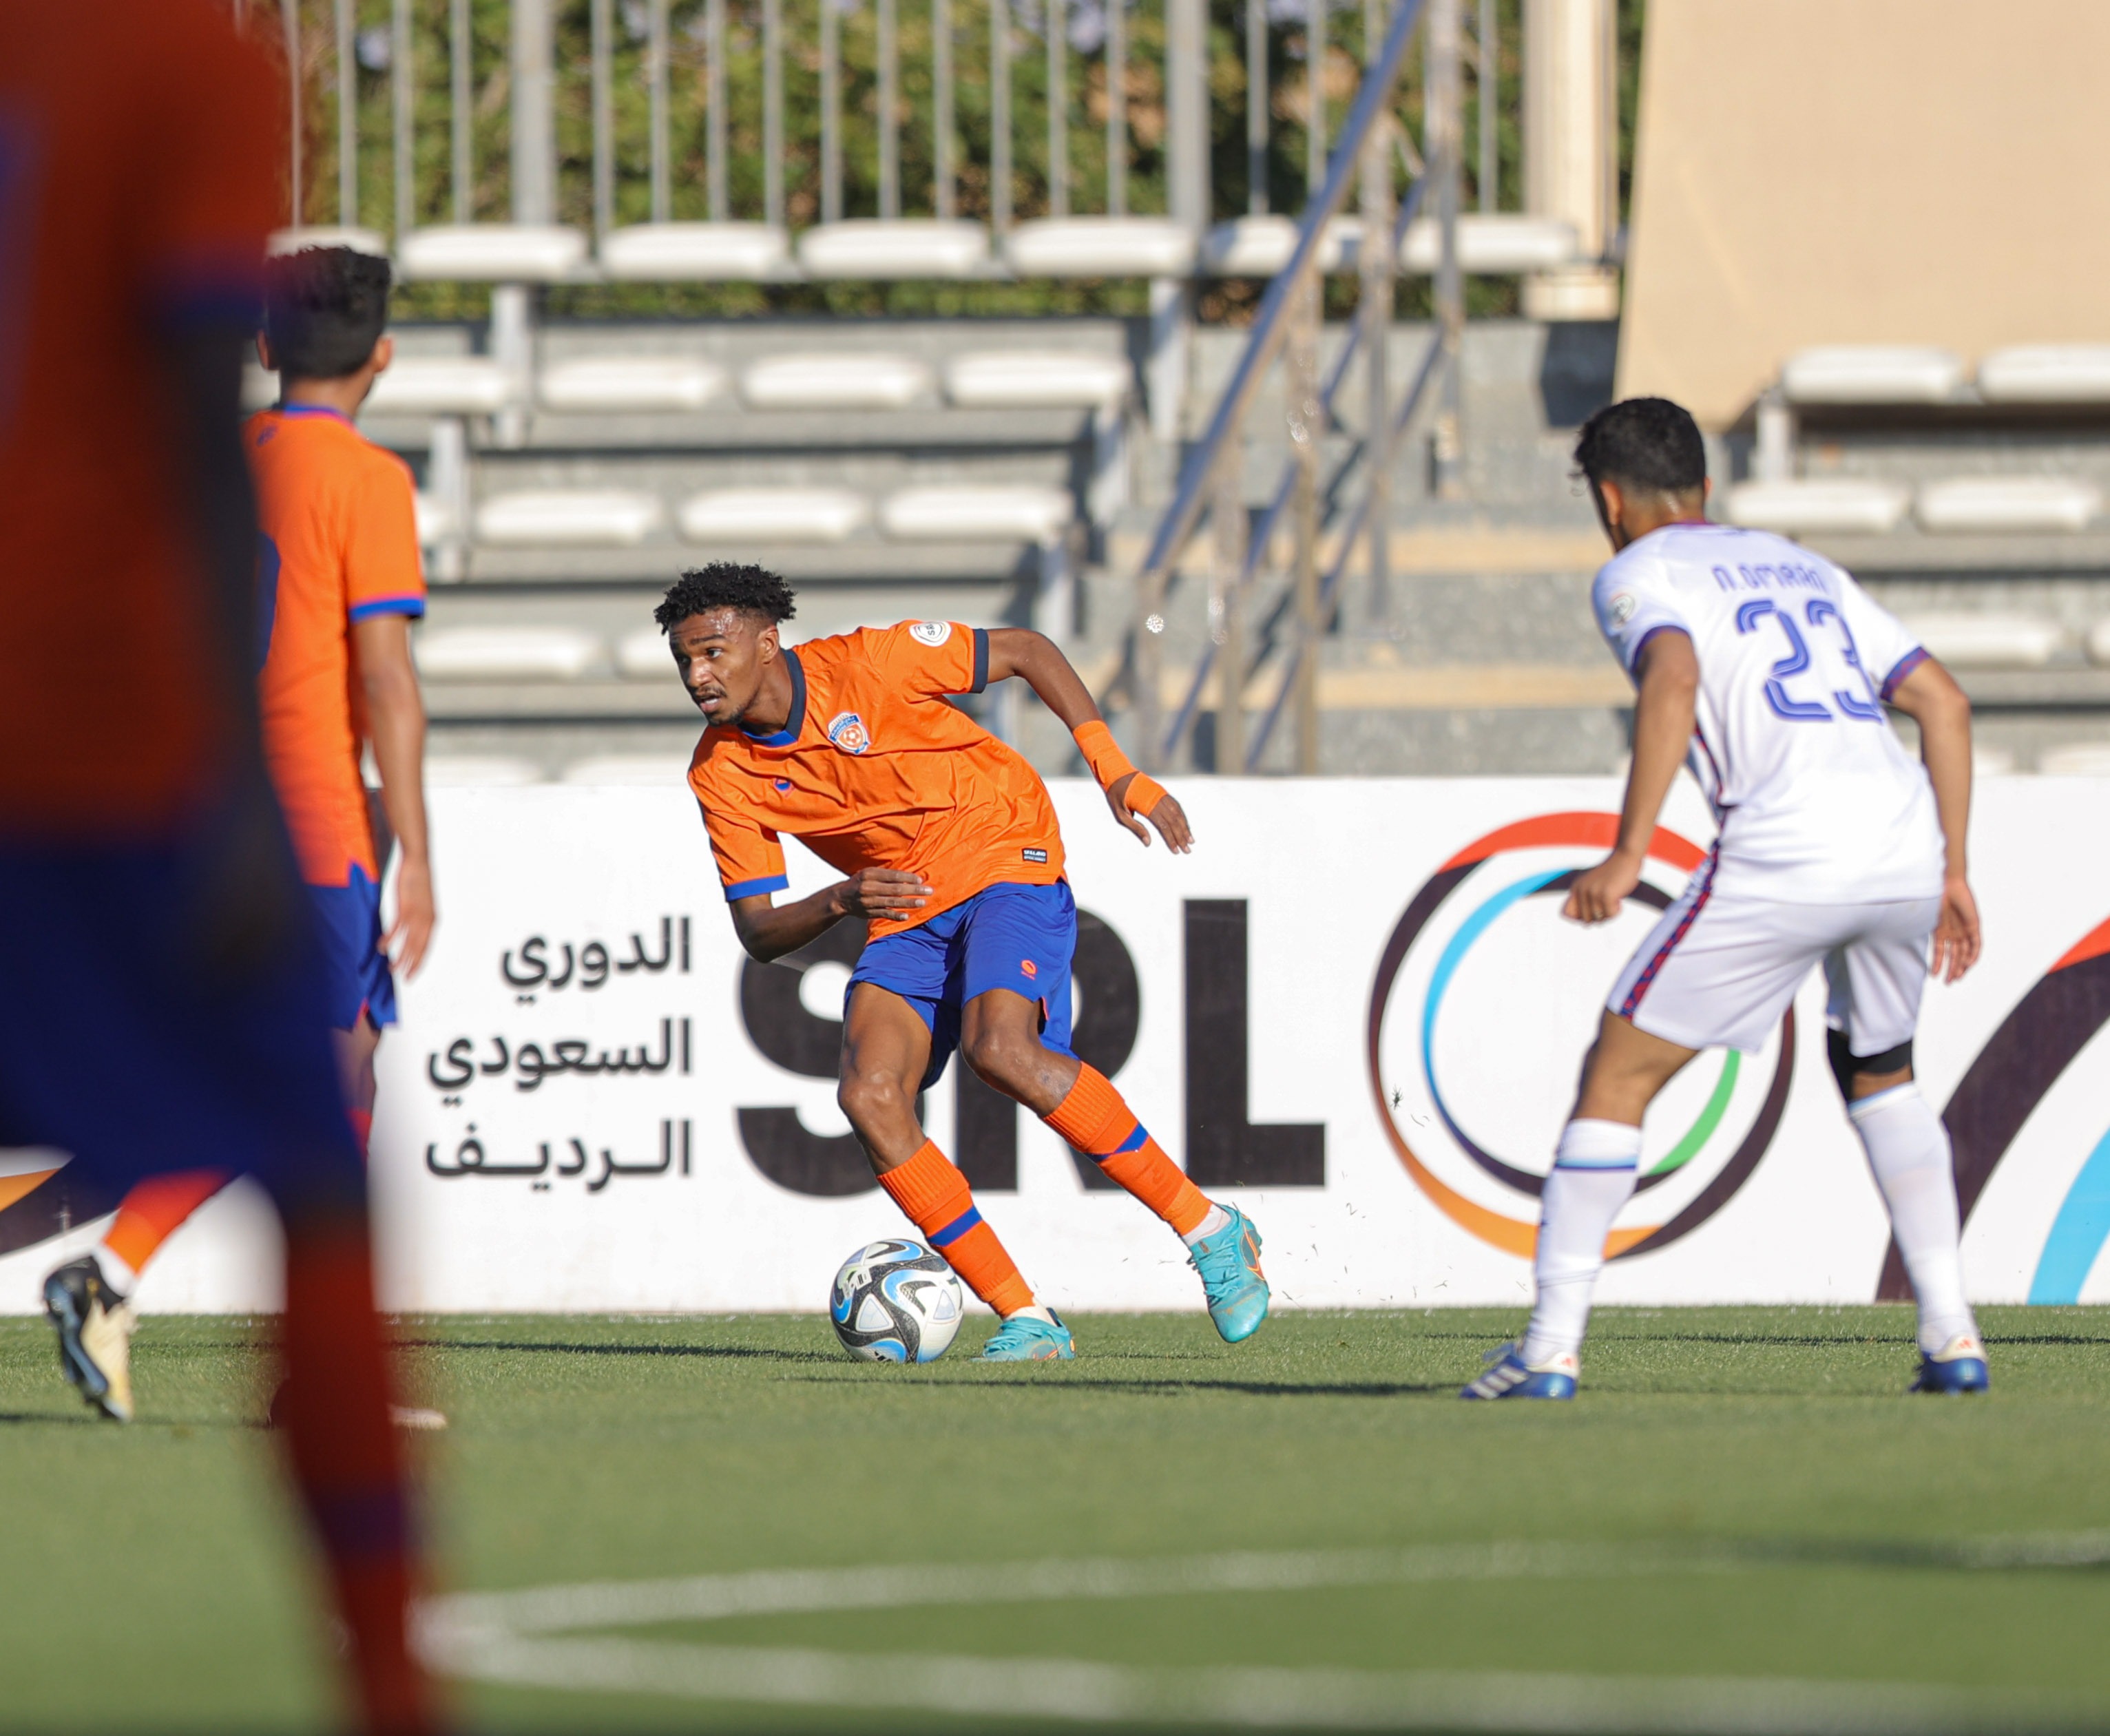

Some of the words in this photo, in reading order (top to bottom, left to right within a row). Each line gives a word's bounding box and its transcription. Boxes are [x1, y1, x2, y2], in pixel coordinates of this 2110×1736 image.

[1735, 598, 1883, 724] 23
[503, 917, 689, 1003] الدوري
[429, 1019, 690, 1105] السعودي
[735, 897, 1326, 1196] SRL
